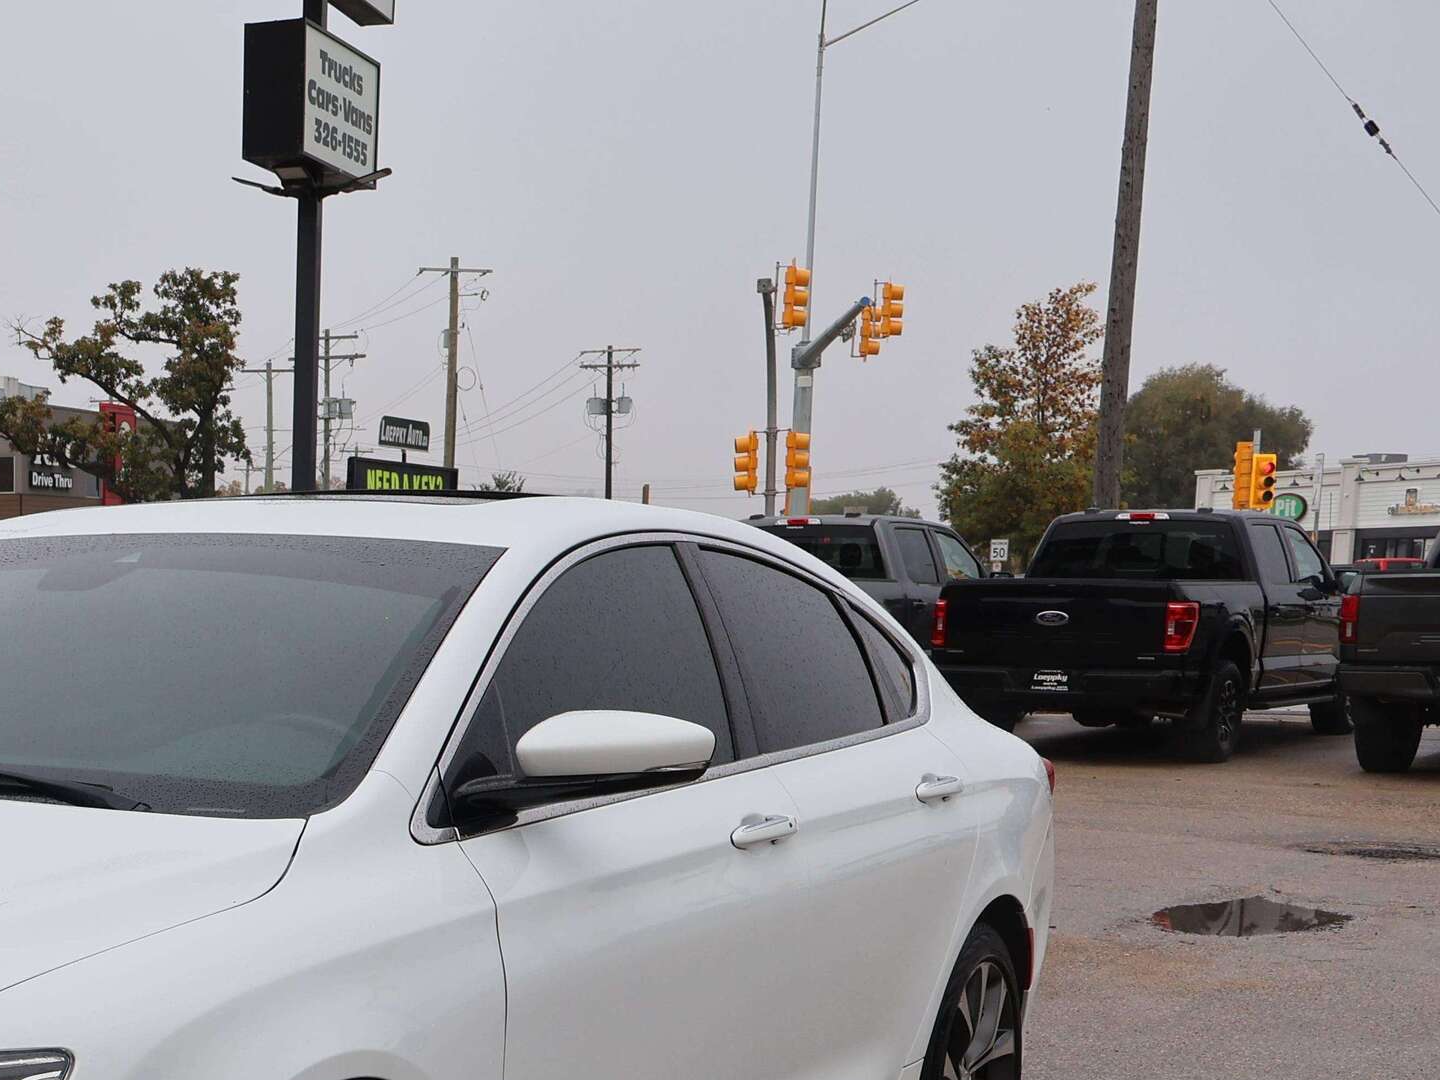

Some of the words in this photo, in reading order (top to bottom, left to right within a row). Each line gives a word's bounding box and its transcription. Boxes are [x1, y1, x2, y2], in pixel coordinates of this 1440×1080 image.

[319, 49, 364, 97] Trucks
[313, 117, 368, 167] 326-1555
[32, 471, 54, 487] Drive
[53, 473, 73, 488] Thru
[366, 468, 400, 490] NEED
[402, 473, 410, 491] A
[1274, 498, 1297, 517] Pit
[992, 547, 1006, 559] 50
